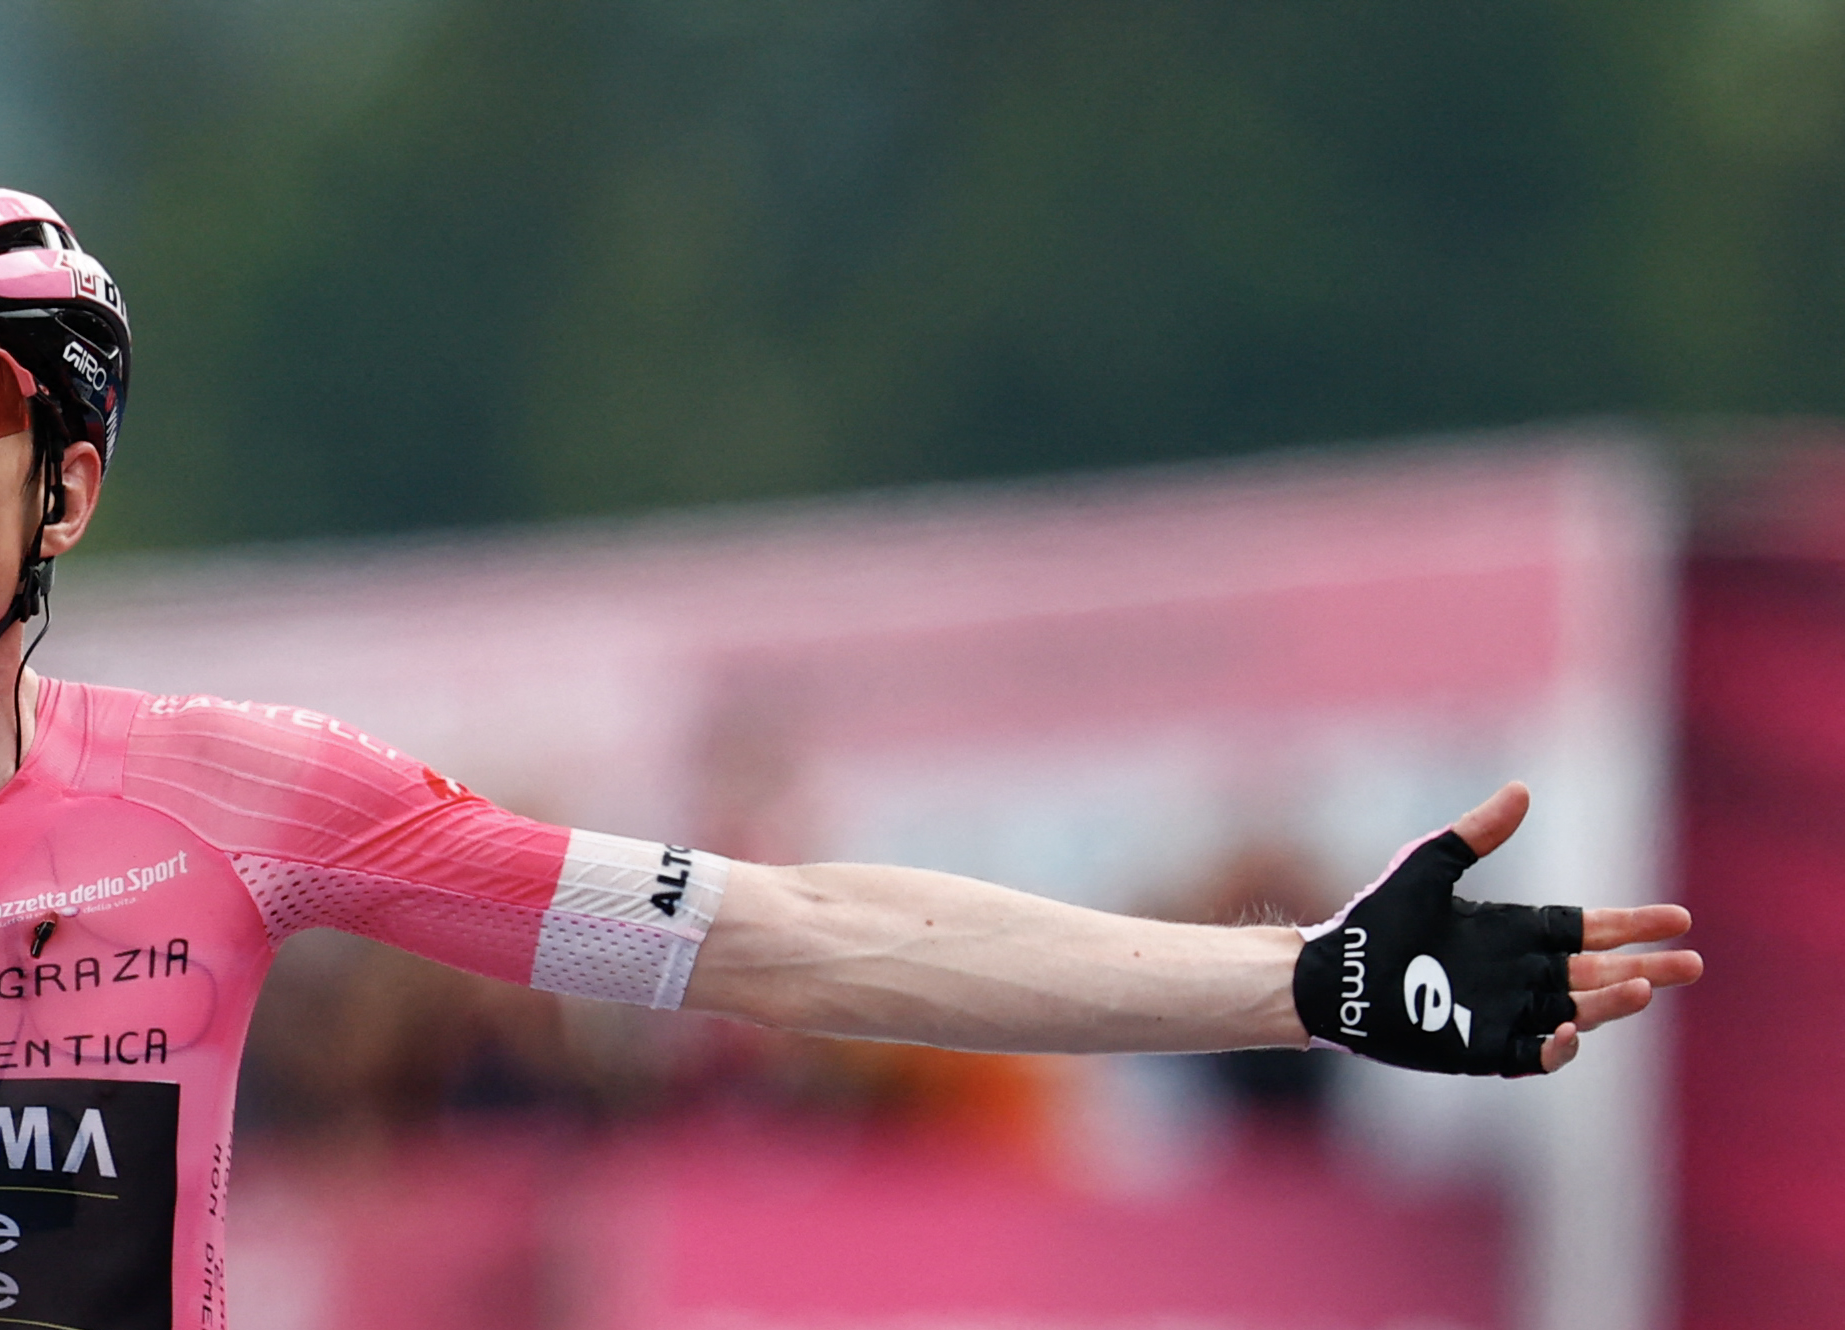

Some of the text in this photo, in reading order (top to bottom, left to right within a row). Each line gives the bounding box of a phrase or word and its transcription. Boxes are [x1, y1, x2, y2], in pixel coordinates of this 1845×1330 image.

[63, 341, 106, 390] GIRO
[71, 876, 124, 904] dello
[126, 850, 188, 892] Sport
[1340, 927, 1370, 1037] nimbl
